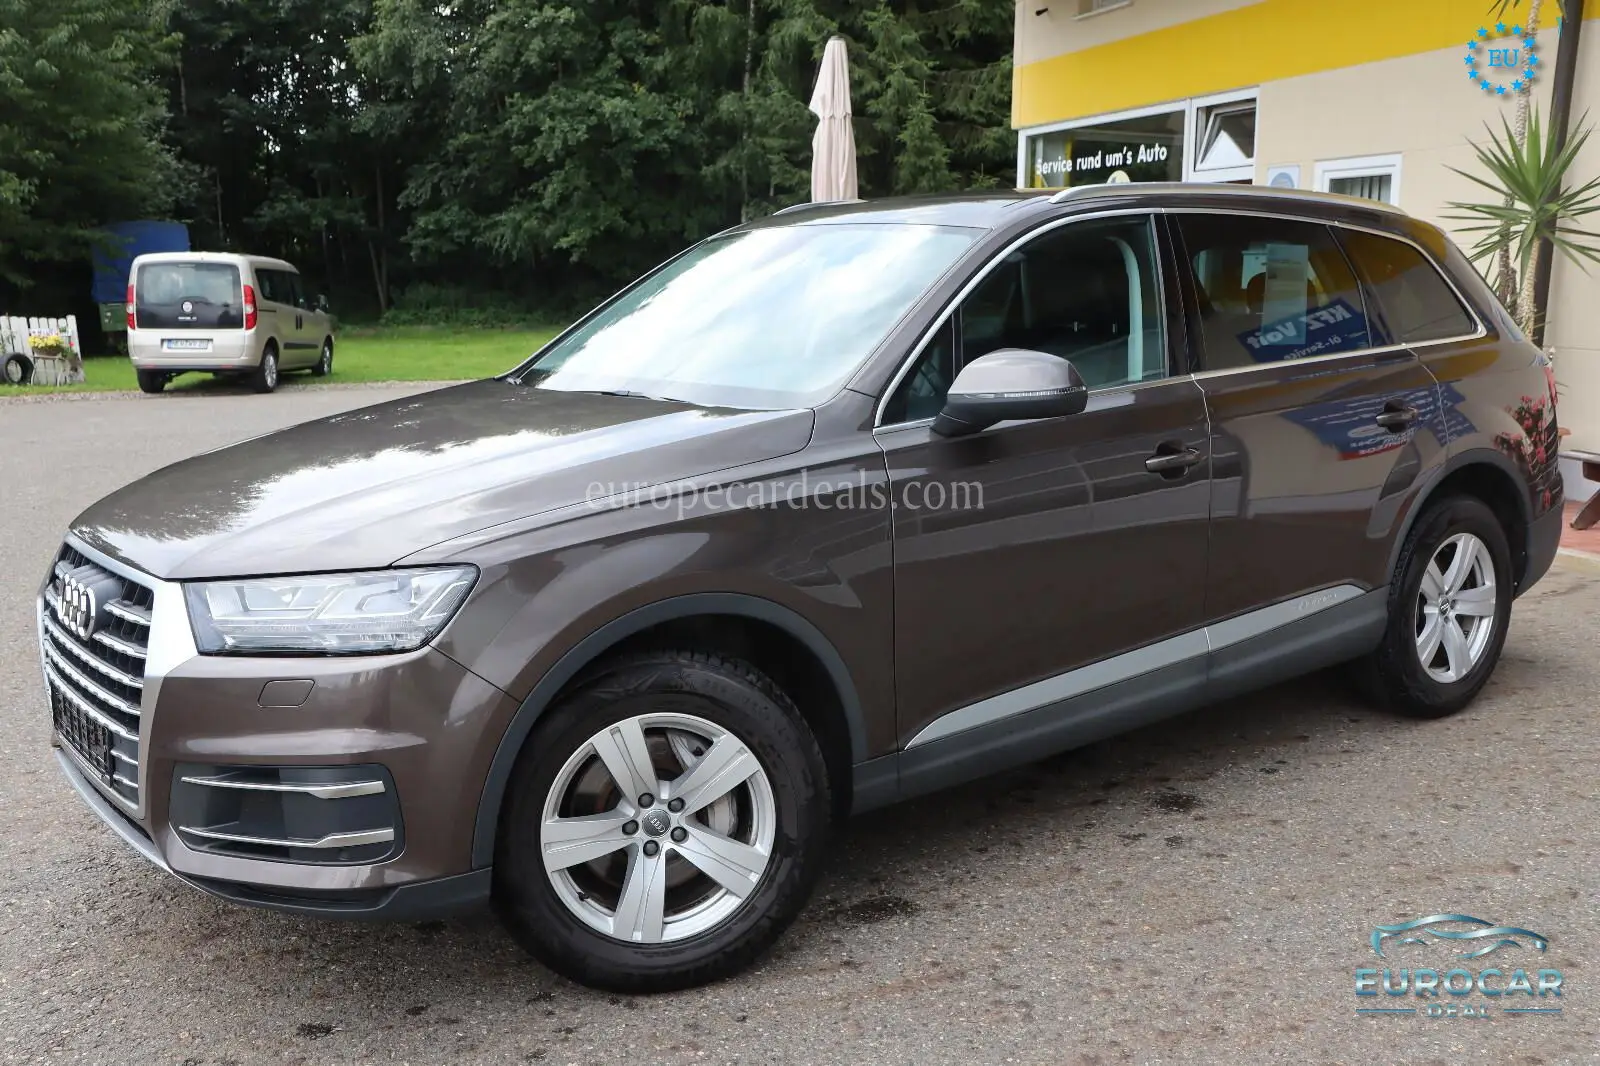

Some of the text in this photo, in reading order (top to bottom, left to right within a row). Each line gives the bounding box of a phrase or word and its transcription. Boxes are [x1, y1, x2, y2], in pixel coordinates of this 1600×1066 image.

[1035, 142, 1168, 175] Service rund um's Auto
